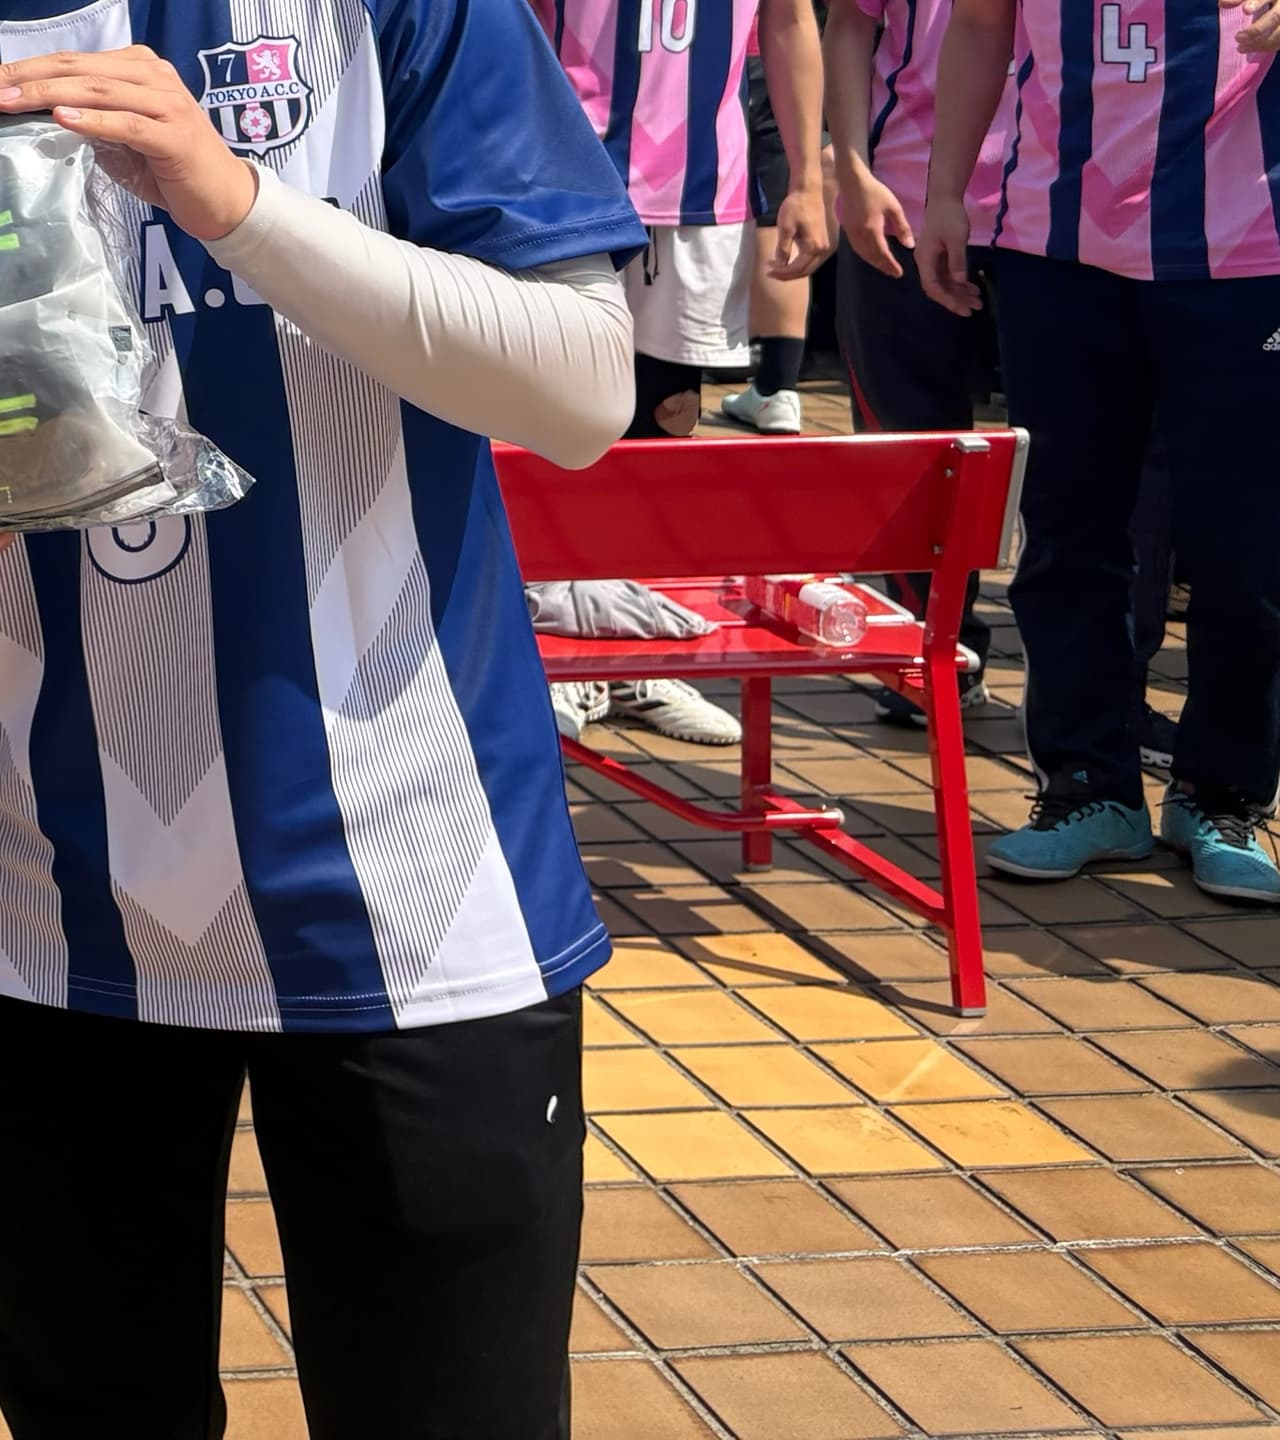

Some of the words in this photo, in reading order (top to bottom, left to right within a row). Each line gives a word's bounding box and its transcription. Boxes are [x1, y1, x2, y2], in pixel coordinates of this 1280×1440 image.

[1101, 3, 1157, 83] 4
[217, 53, 236, 83] 7
[206, 86, 257, 105] TOKYO
[260, 81, 300, 98] A.C.C
